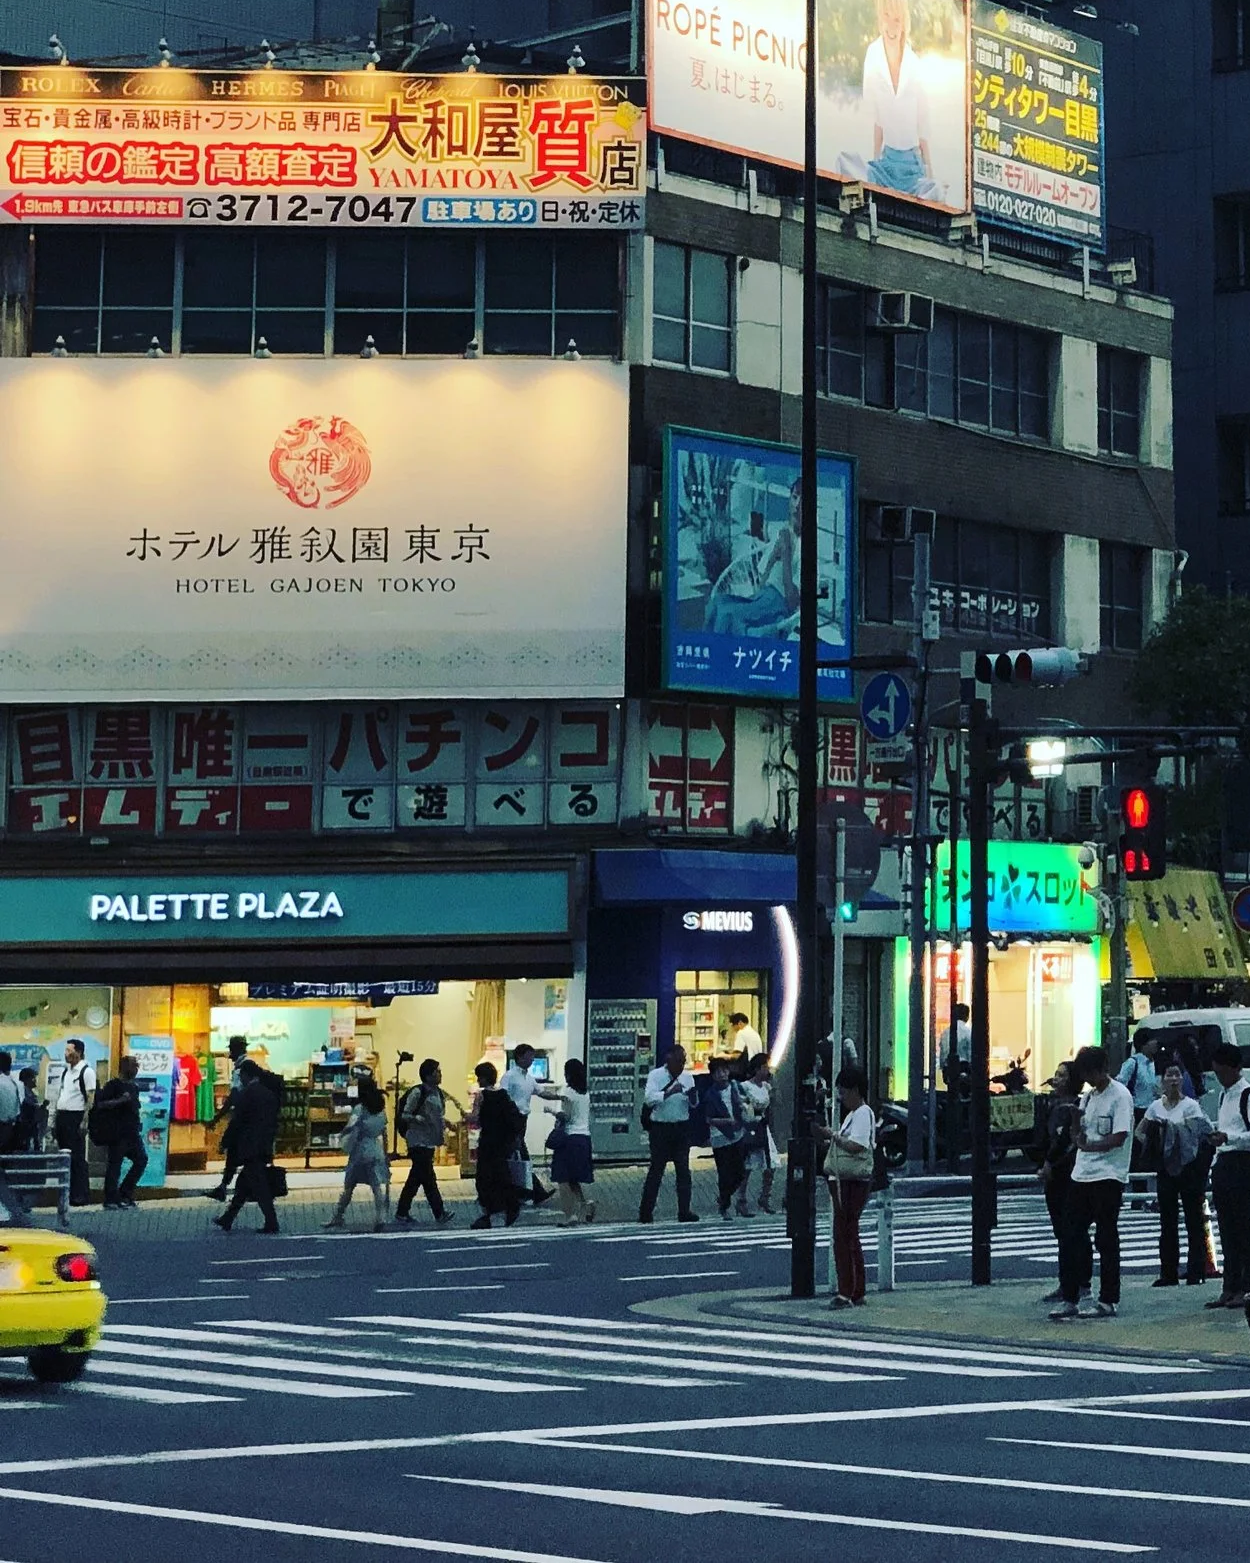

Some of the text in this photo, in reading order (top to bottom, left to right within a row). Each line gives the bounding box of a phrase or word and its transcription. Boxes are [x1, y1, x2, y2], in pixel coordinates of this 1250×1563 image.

[22, 76, 102, 94] ROLEX
[211, 79, 304, 97] HERMES
[689, 56, 785, 112] 夏、はじまる。
[3, 108, 362, 134] 宝石・貴金属・高級時計・ブランド品 専門店
[974, 68, 1099, 145] シティタワー目黒
[370, 99, 521, 159] 大和屋
[529, 98, 640, 188] 質店
[11, 142, 356, 184] 信頼の鑑定 高額査定
[368, 167, 519, 190] YAMATOYA
[1004, 163, 1099, 211] モデルルームオープン
[216, 195, 417, 223] 3712-7047
[426, 200, 535, 222] 駐車場あり
[542, 199, 641, 224] 日・祝・定休
[986, 190, 1057, 228] 0120-027-020
[175, 577, 458, 596] HOTEL GAJOEN TOKYO
[732, 645, 793, 673] ナツイチ
[16, 706, 611, 785] 目黒唯一パチンコ
[90, 890, 344, 922] PALETTE PLAZA
[702, 910, 754, 932] MEVIUS
